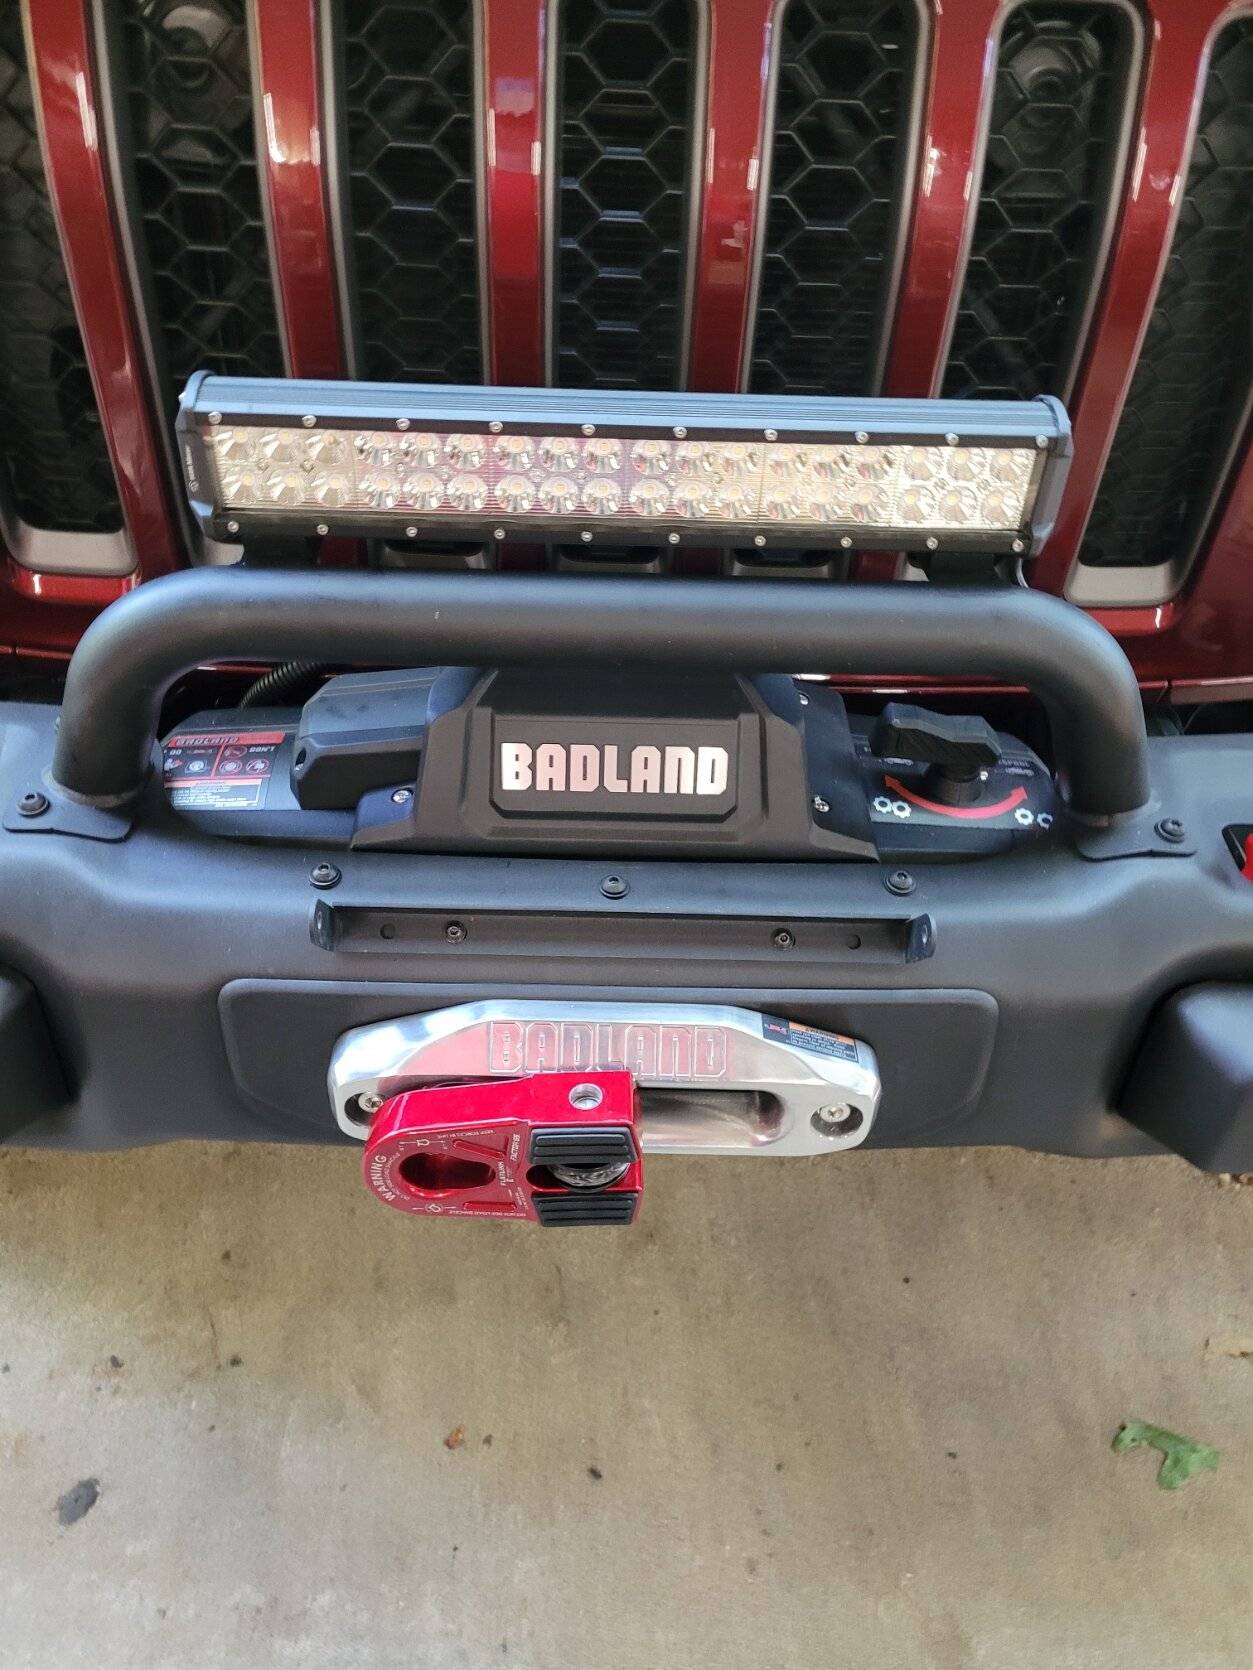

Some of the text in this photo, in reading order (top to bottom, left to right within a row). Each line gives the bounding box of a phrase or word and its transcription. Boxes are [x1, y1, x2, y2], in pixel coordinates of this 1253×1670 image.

[501, 742, 729, 796] BADLAND
[490, 1020, 728, 1078] BADLAND
[369, 1154, 397, 1202] WARNING
